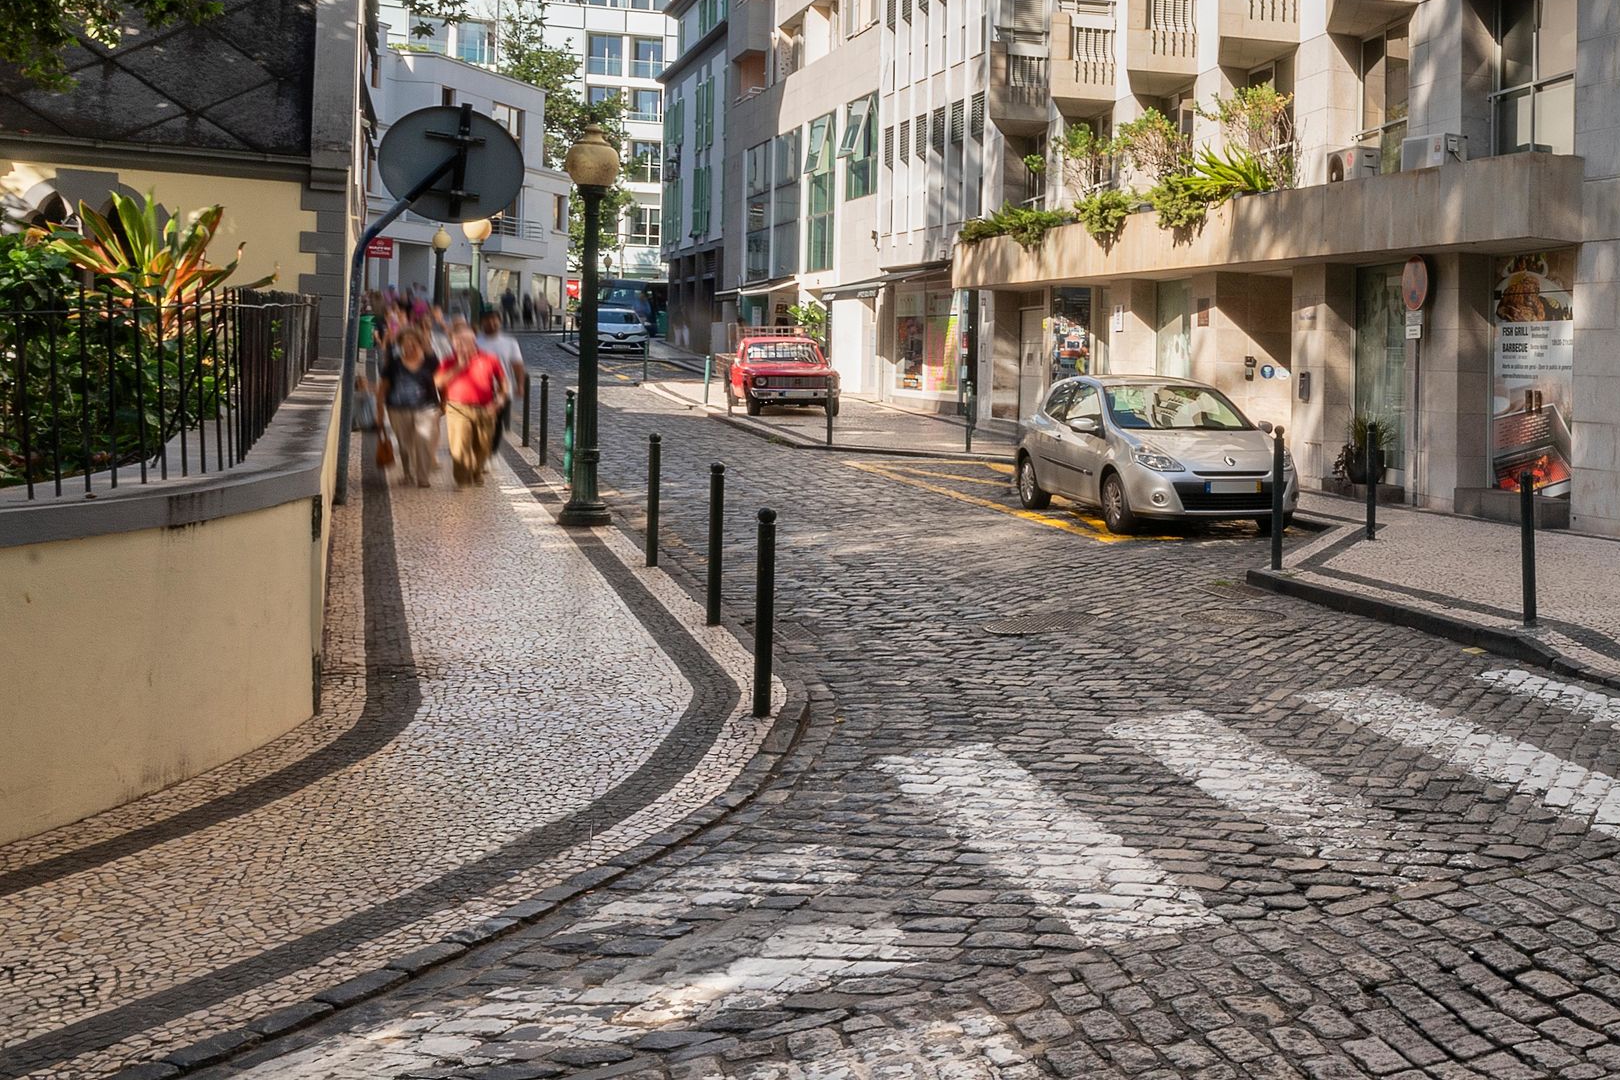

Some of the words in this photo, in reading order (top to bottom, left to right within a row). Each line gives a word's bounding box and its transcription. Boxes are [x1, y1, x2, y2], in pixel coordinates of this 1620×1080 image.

[1503, 327, 1513, 336] FISH
[1514, 326, 1528, 336] GRILL
[1502, 343, 1528, 352] BARBECUE
